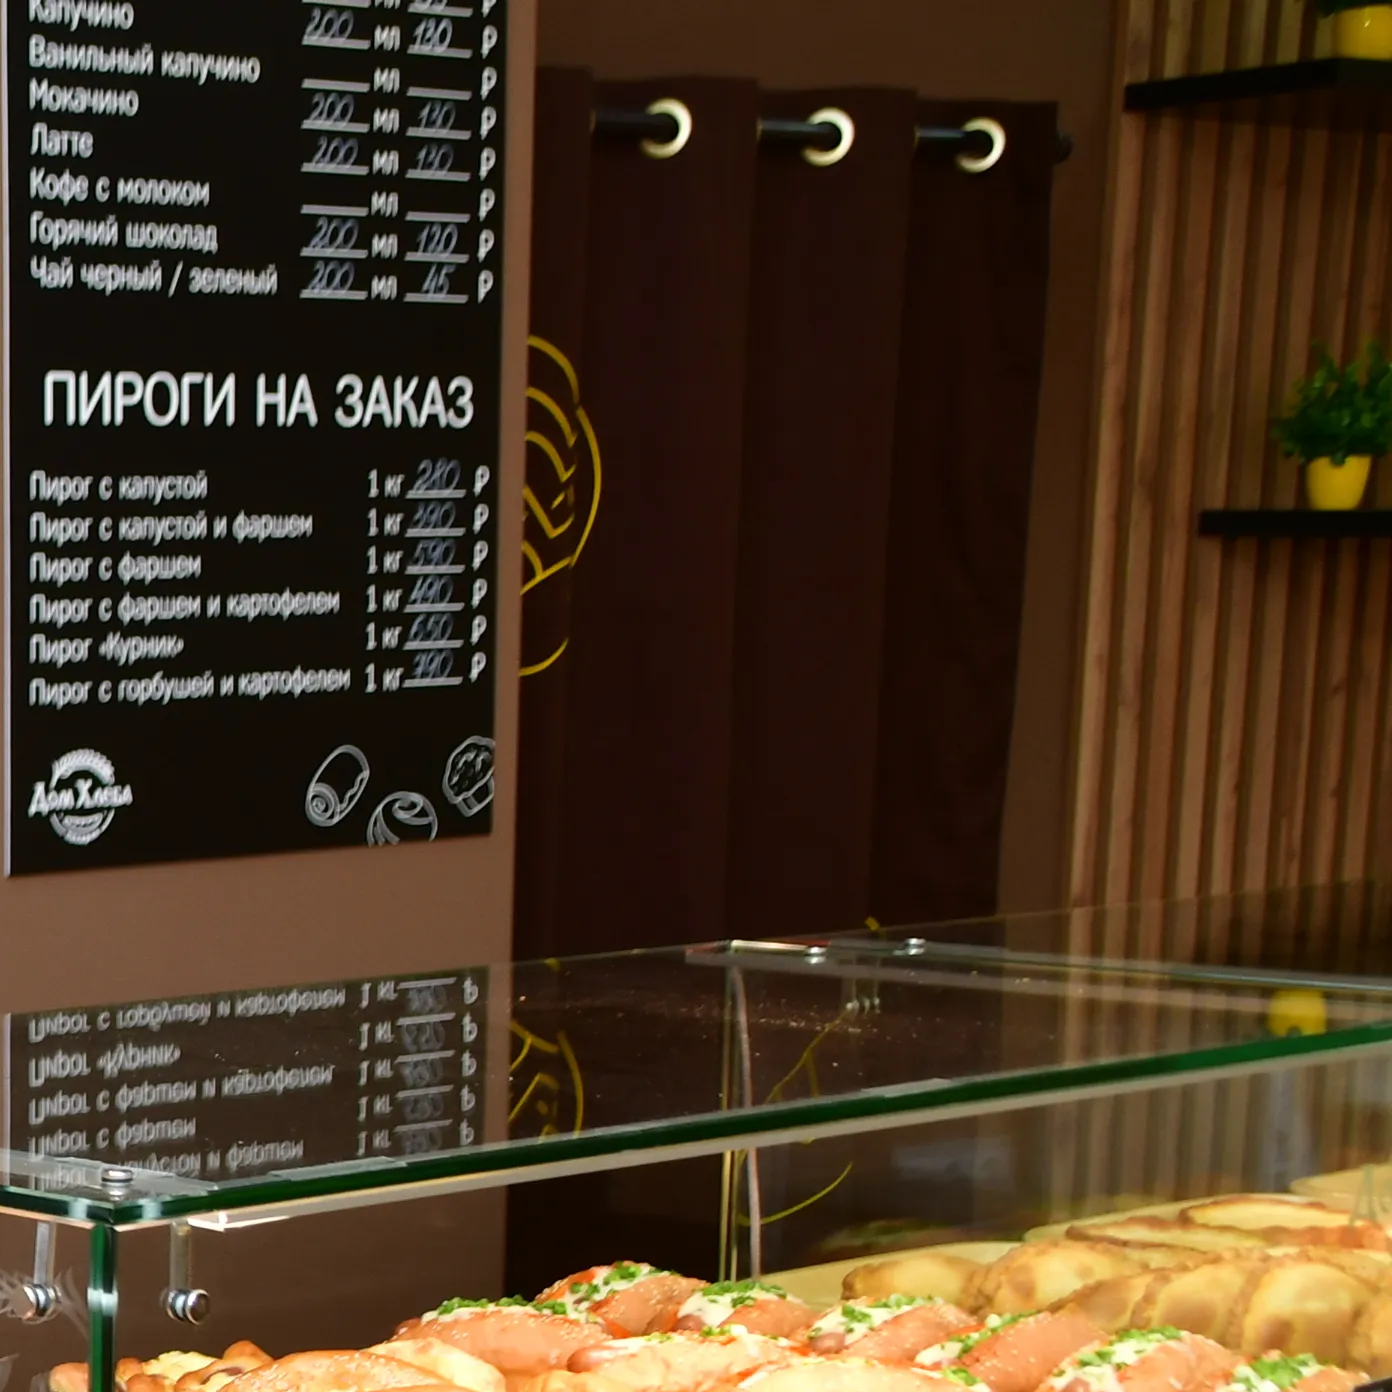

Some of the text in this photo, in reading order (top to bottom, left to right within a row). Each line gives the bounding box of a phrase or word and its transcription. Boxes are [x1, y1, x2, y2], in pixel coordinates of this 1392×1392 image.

[373, 24, 401, 52] мл
[29, 34, 400, 94] Ванильный капучино мл
[29, 77, 139, 116] Мокачино
[372, 107, 400, 134] мл
[31, 122, 93, 158] Латте
[372, 149, 399, 176] мл
[30, 166, 399, 217] Кофе с молоком мл
[30, 211, 118, 251] Горячий
[125, 221, 218, 254] шоколад
[371, 233, 398, 259] мл
[30, 255, 74, 289] Чай
[80, 259, 162, 296] черный
[189, 264, 278, 295] зеленый
[371, 275, 398, 301] мл
[43, 369, 474, 429] ПИРОГИ НА ЗАКАЗ
[29, 469, 93, 507] Пирог
[98, 475, 113, 500] с
[118, 469, 208, 505] капустой
[368, 468, 379, 498] 1
[384, 474, 405, 498] кг
[29, 511, 93, 548] Пирог
[98, 516, 113, 542] с
[118, 510, 208, 546] капустой
[212, 515, 227, 539] и
[232, 509, 313, 543] фаршем
[367, 507, 379, 537] 1
[383, 512, 404, 537] кг
[29, 551, 93, 588] Пирог
[98, 556, 113, 581] с
[117, 550, 202, 586] фаршем
[367, 545, 379, 575] 1
[382, 550, 404, 574] кг
[29, 592, 93, 629] Пирог
[98, 597, 113, 622] с
[117, 591, 202, 627] фаршем
[207, 595, 221, 619] и
[226, 587, 340, 622] картофелем
[366, 584, 378, 613] 1
[382, 589, 403, 612] кг
[29, 633, 92, 669] Пирог
[98, 631, 185, 666] «Курник»
[366, 621, 377, 651] 1
[381, 626, 402, 649] кг
[29, 677, 92, 710] Пирог
[97, 680, 112, 703] с
[117, 670, 214, 706] горбушей
[219, 674, 234, 698] и
[237, 665, 351, 699] картофелем
[365, 662, 376, 693] 1
[382, 667, 404, 692] кг
